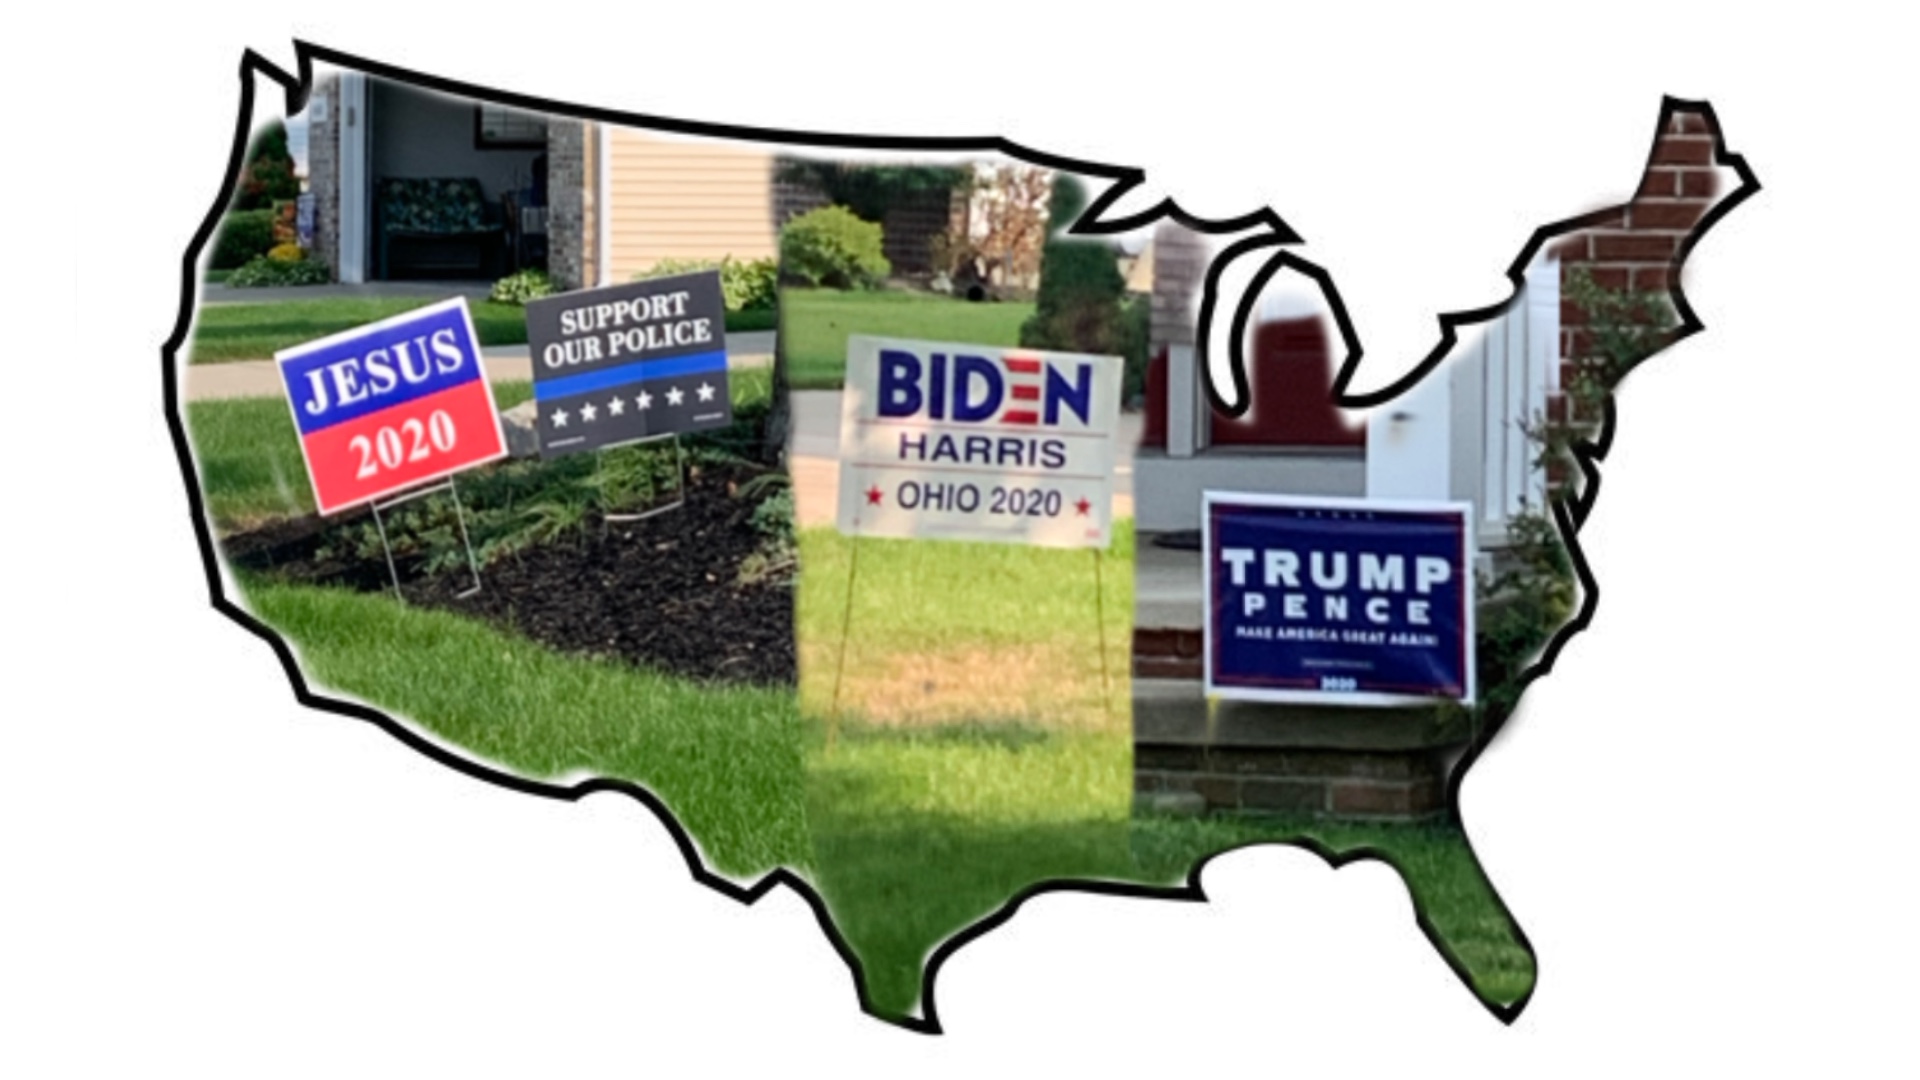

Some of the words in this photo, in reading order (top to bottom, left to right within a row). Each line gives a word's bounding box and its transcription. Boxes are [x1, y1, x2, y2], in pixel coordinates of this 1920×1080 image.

[560, 291, 689, 335] SUPPORT
[543, 334, 602, 369] OUR
[607, 318, 712, 357] POLICE
[303, 328, 464, 415] JESUS
[877, 349, 1092, 426] BIDEN
[349, 409, 456, 480] 2020
[899, 432, 1067, 468] HARRIS
[897, 481, 980, 513] OHIO
[990, 487, 1062, 517] 2020
[1221, 547, 1451, 593] TRUMP
[1243, 592, 1431, 625] PENCE
[1236, 626, 1272, 639] MAKE
[1276, 627, 1339, 641] AMERICA
[1342, 630, 1386, 644] GREAT
